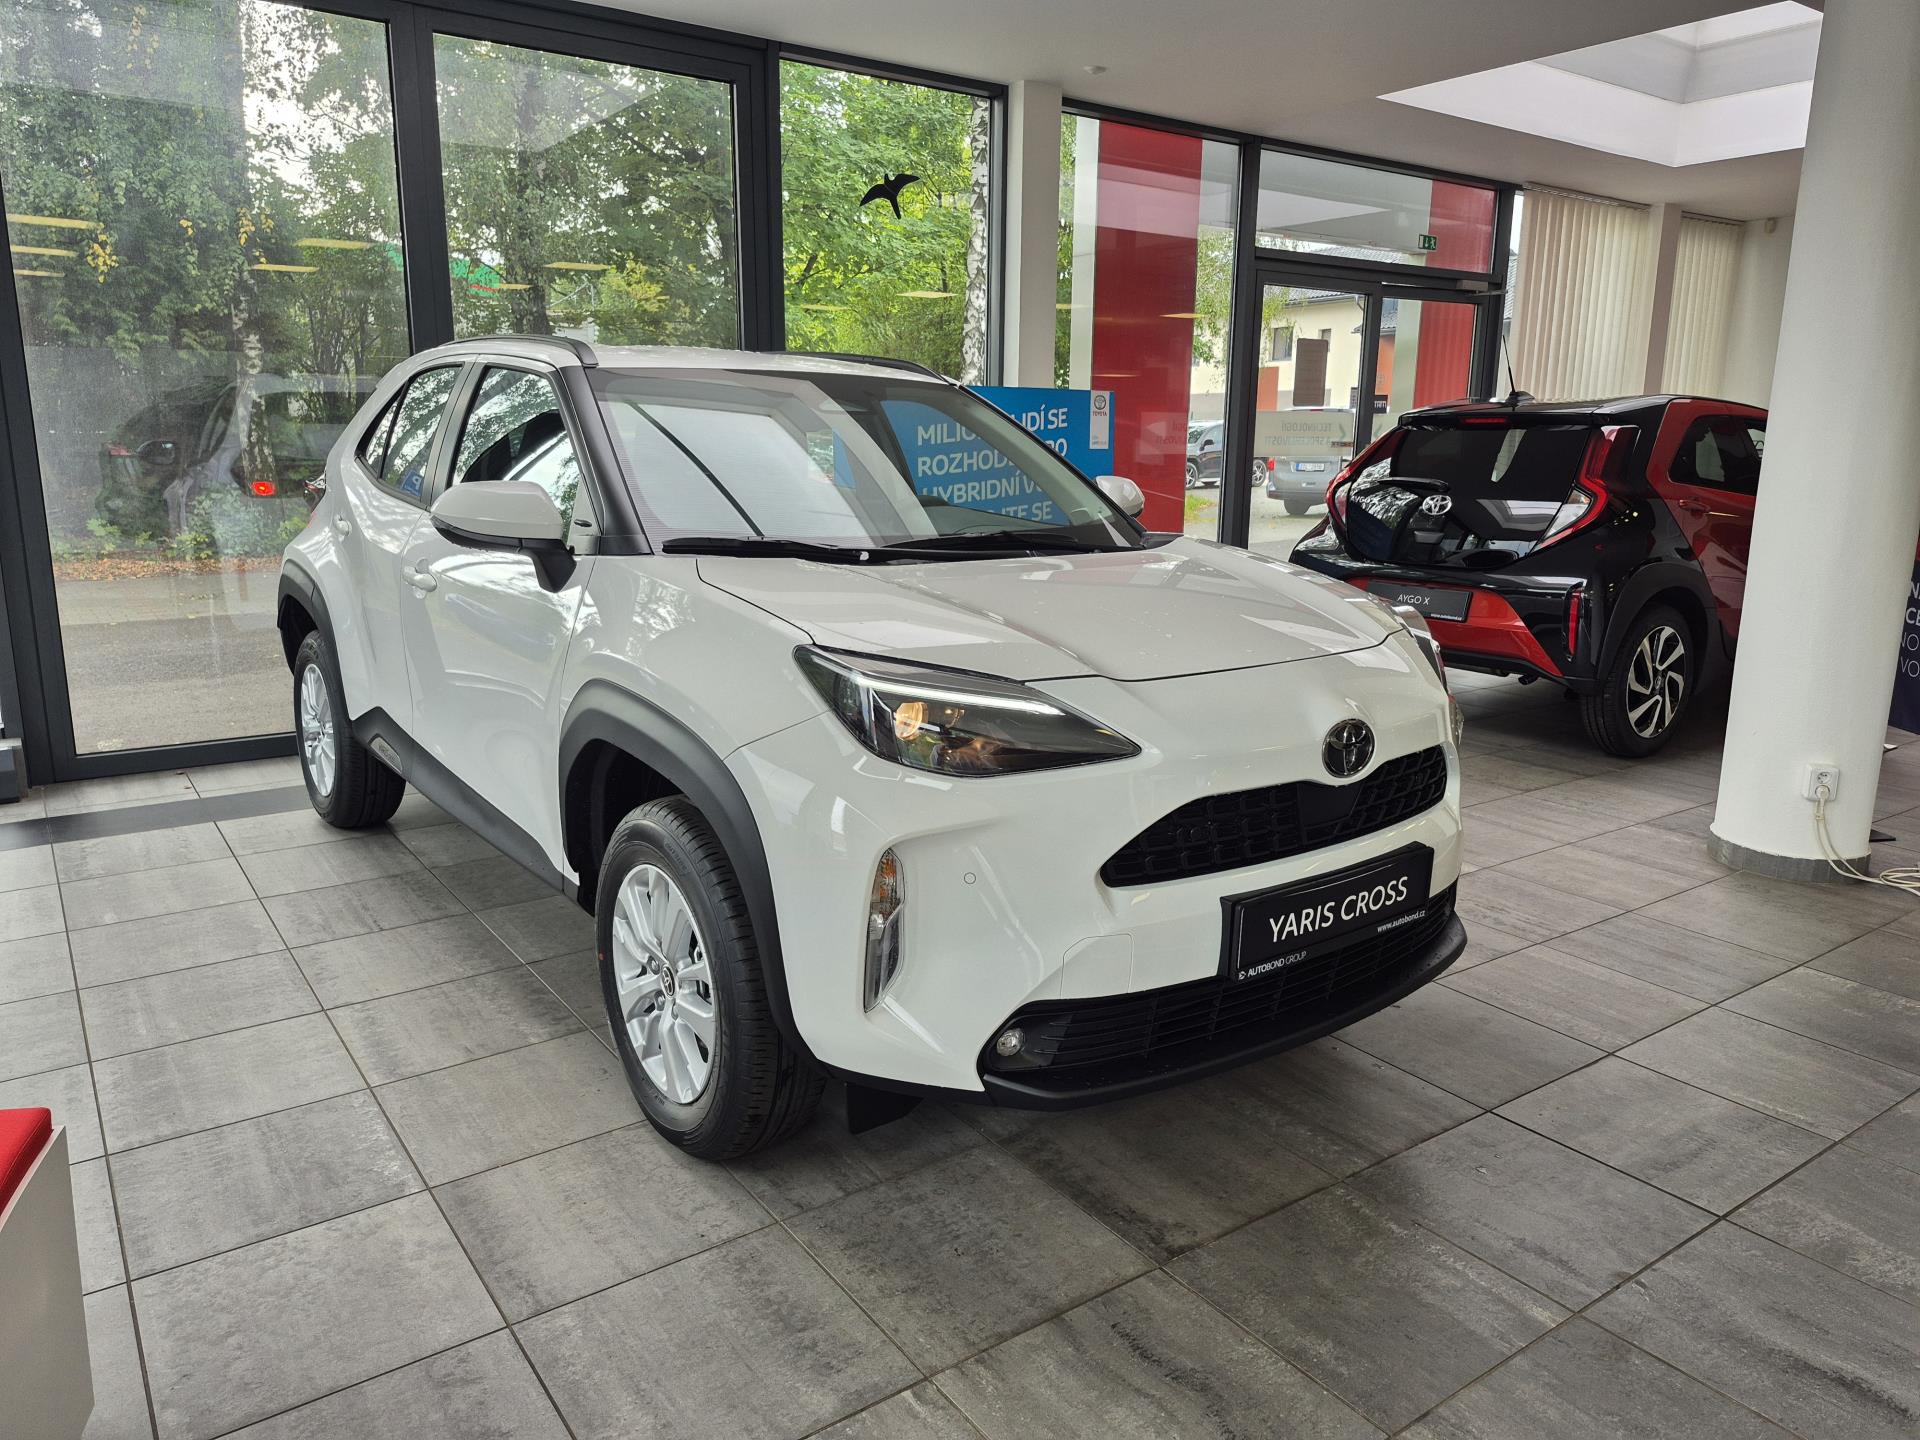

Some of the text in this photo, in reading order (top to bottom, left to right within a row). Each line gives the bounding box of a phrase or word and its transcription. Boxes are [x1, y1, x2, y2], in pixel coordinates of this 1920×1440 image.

[1047, 407, 1068, 429] SE
[1031, 501, 1053, 520] SE
[1396, 593, 1431, 606] AYGO X
[1269, 876, 1409, 943] YARIS CROSS
[1247, 950, 1307, 977] AUTOBOND GROUP
